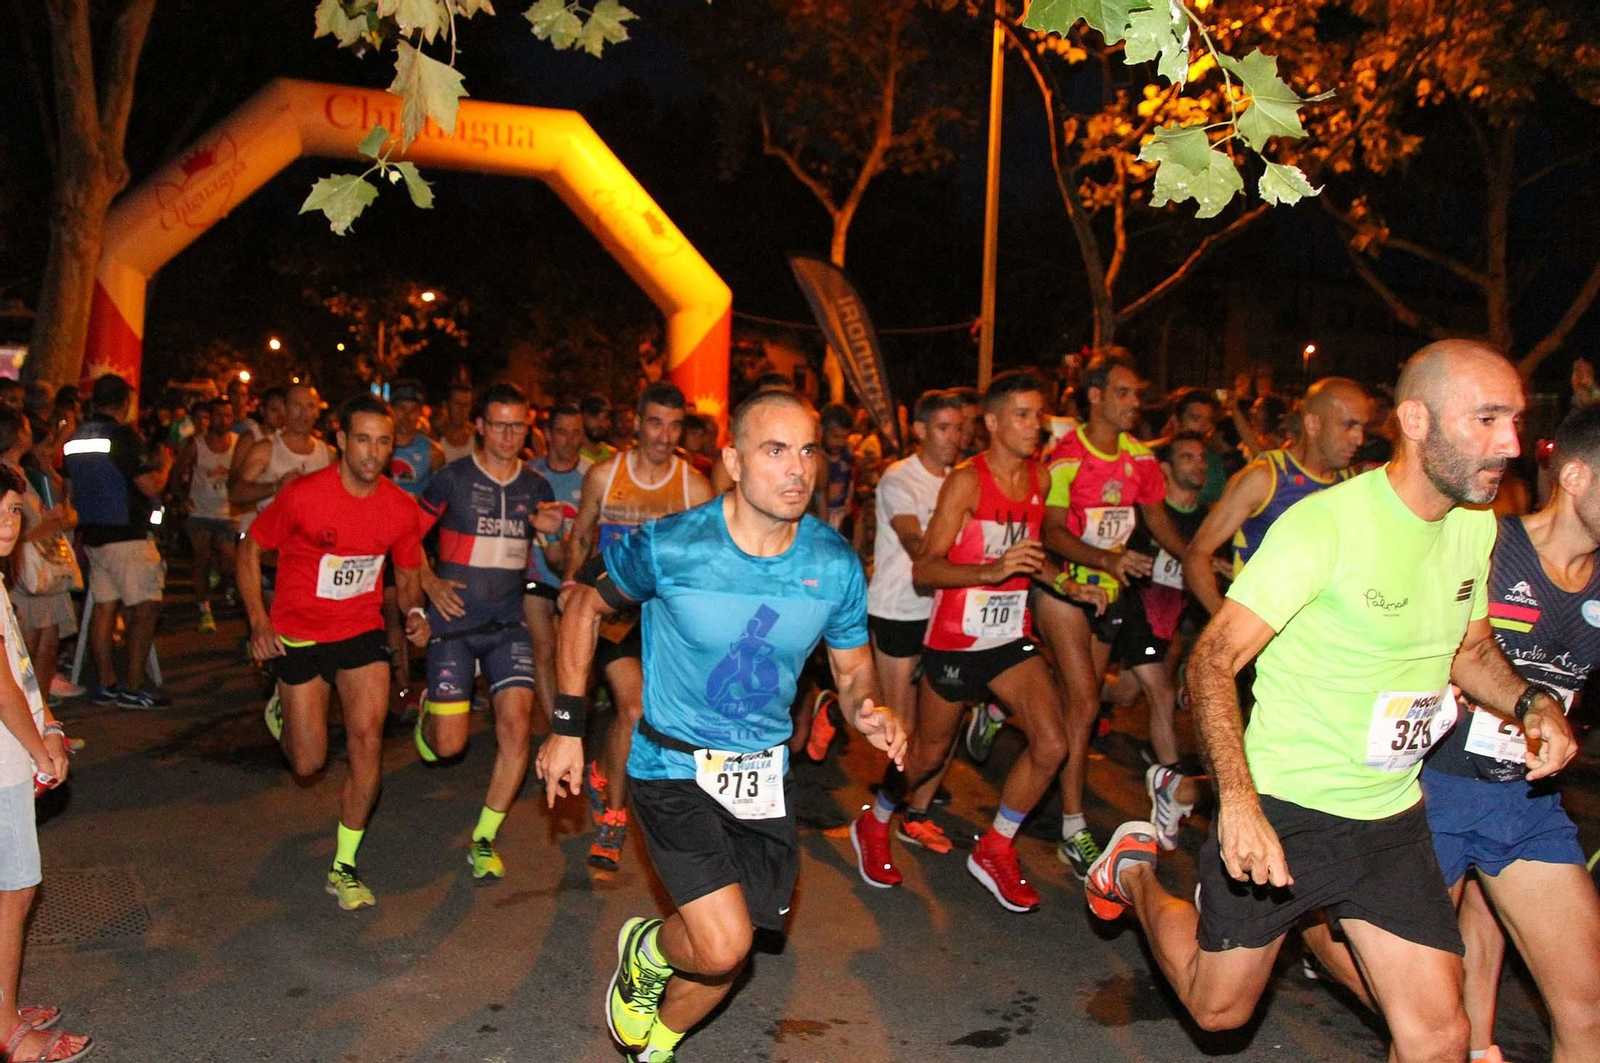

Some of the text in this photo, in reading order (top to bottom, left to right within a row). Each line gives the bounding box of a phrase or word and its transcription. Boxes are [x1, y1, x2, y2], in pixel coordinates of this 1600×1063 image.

[1098, 521, 1120, 536] 617
[1164, 559, 1183, 577] 61
[333, 569, 364, 586] 697
[980, 606, 1010, 624] 110
[1390, 720, 1432, 751] 329
[723, 759, 773, 772] DE HUELVA
[717, 771, 759, 798] 273
